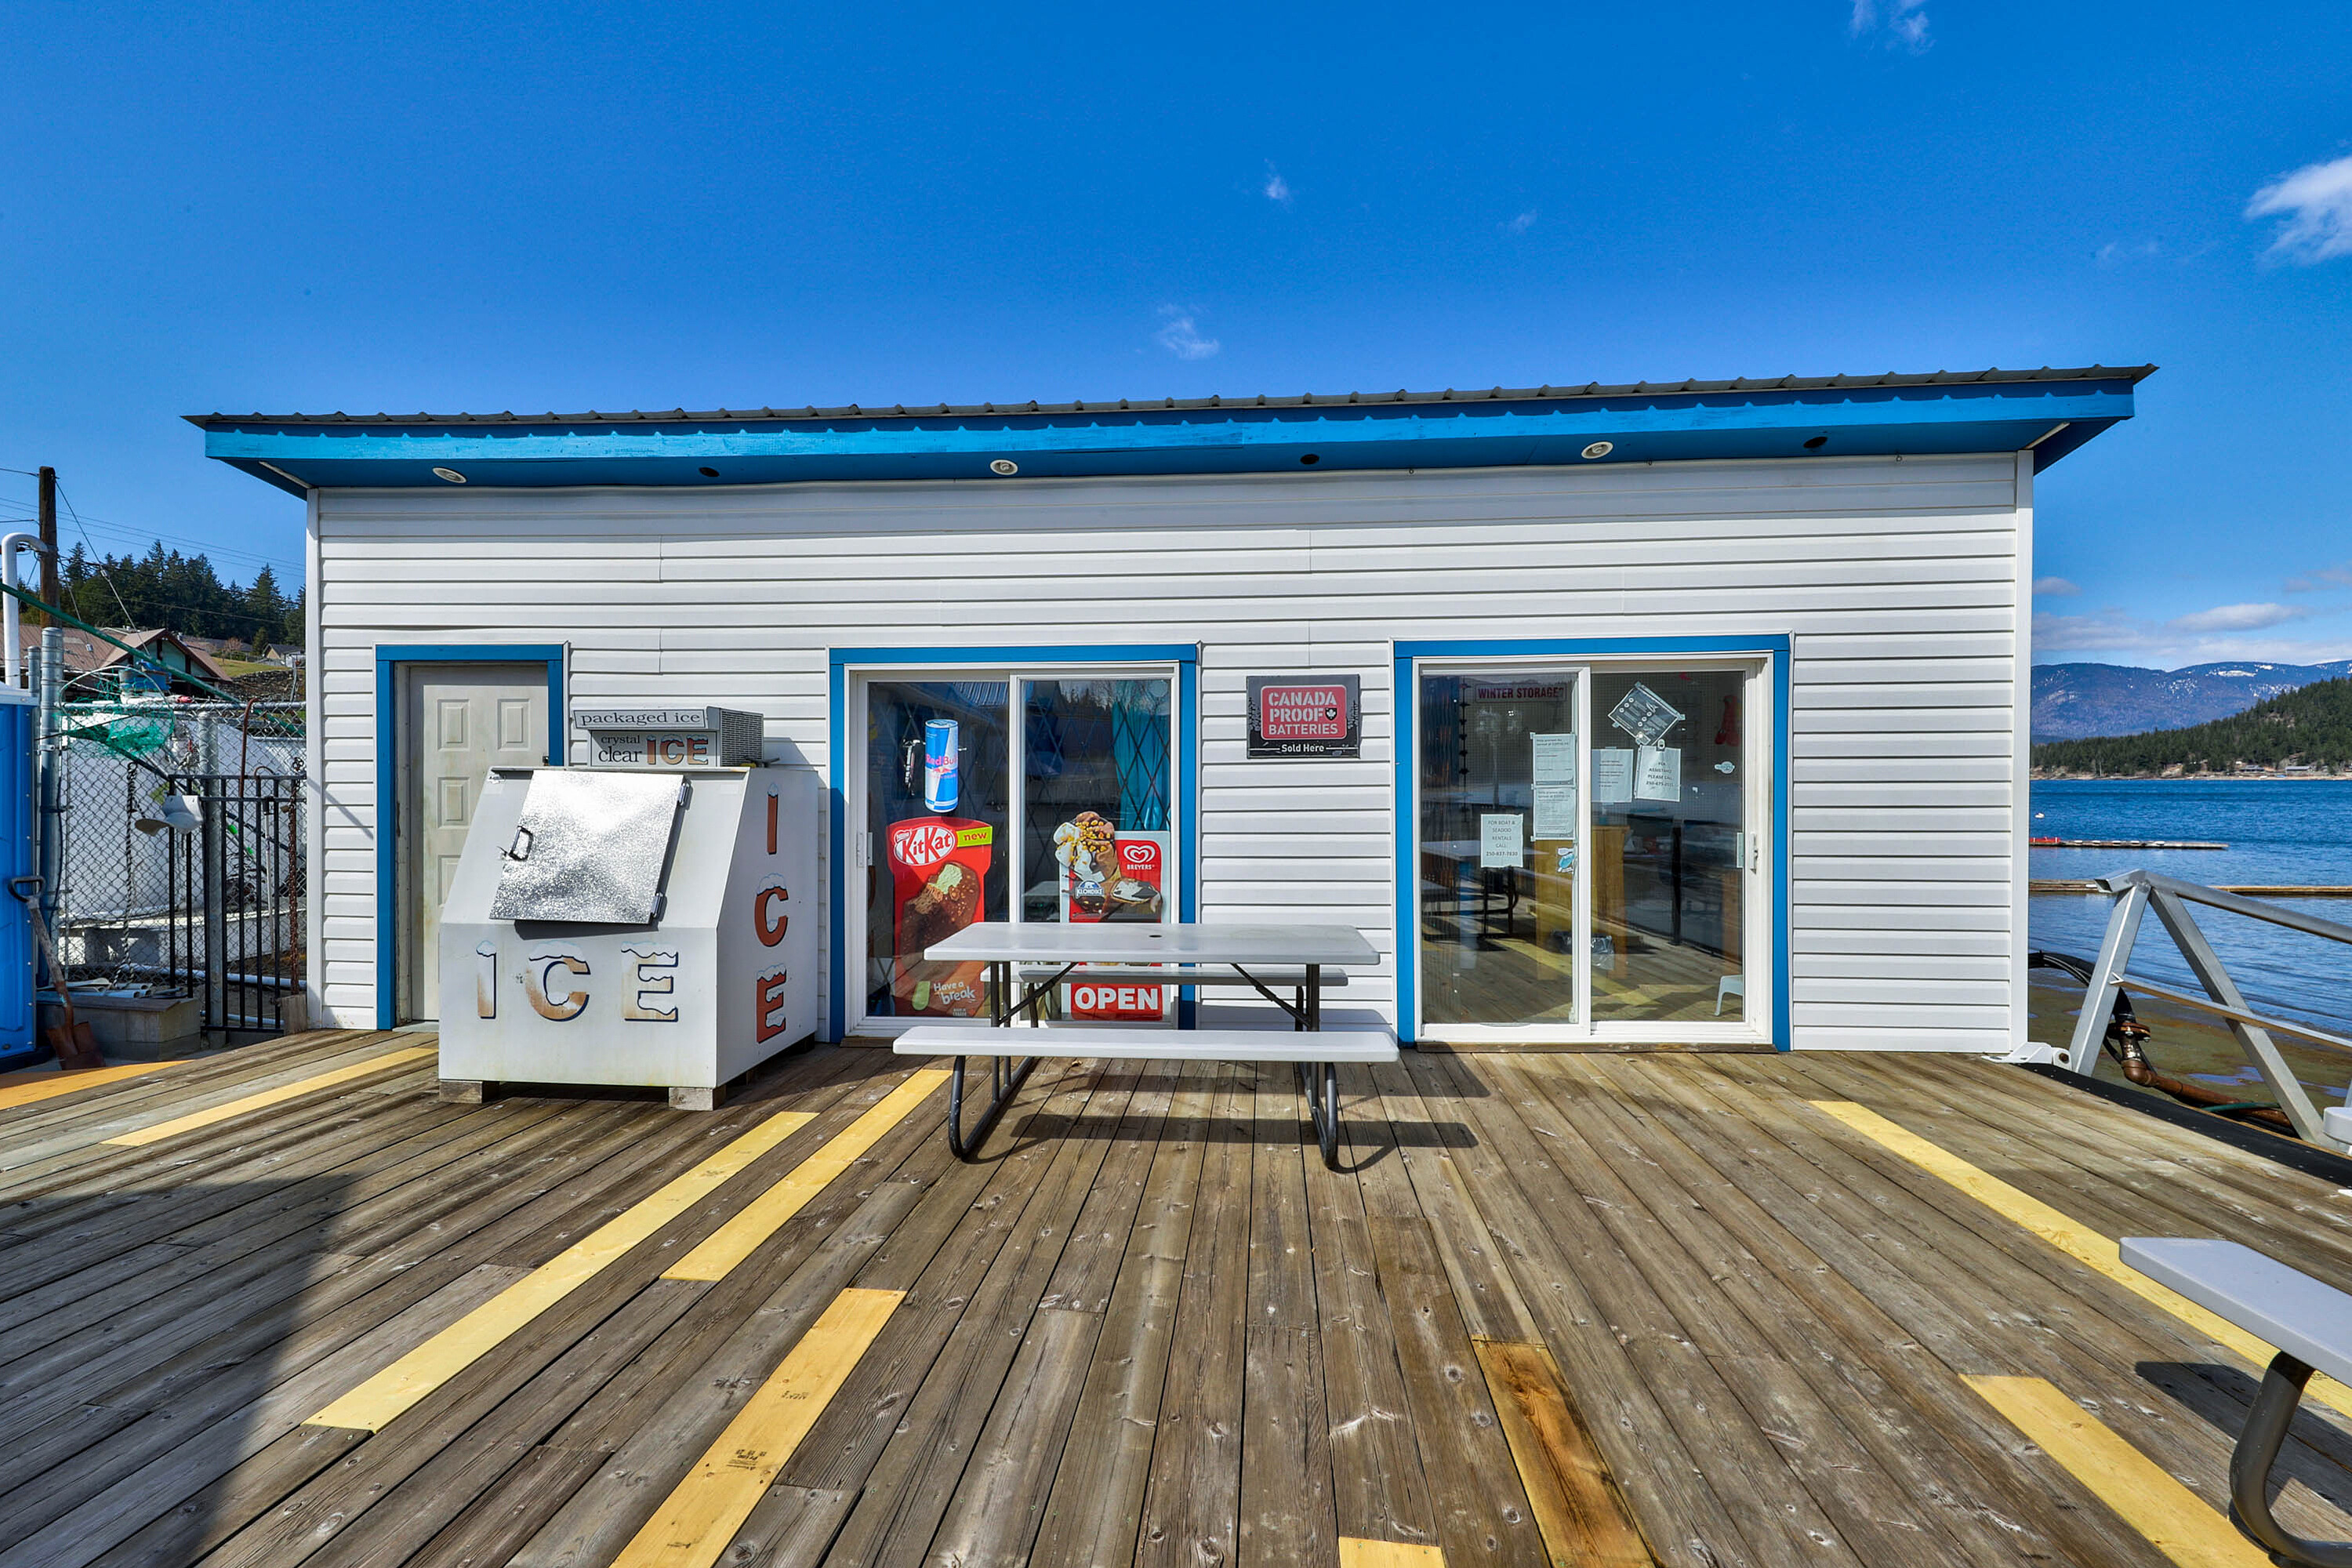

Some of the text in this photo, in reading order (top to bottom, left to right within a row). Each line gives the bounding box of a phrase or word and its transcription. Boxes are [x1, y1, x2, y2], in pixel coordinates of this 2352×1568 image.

[1268, 691, 1337, 706] CANADA
[1478, 688, 1513, 699] WINTER
[581, 712, 700, 726] packaged ice
[1269, 708, 1323, 722] PROOF
[1269, 724, 1338, 735] BATTERIES
[601, 734, 640, 746] crystal
[598, 746, 642, 763] clear
[646, 733, 709, 765] ICE
[925, 753, 942, 765] Red
[902, 827, 951, 865] KitKat
[964, 832, 987, 841] new
[754, 782, 789, 1044] ICE
[476, 940, 679, 1022] ICE
[934, 982, 956, 992] Have
[941, 985, 975, 1005] break
[1074, 986, 1158, 1010] OPEN
